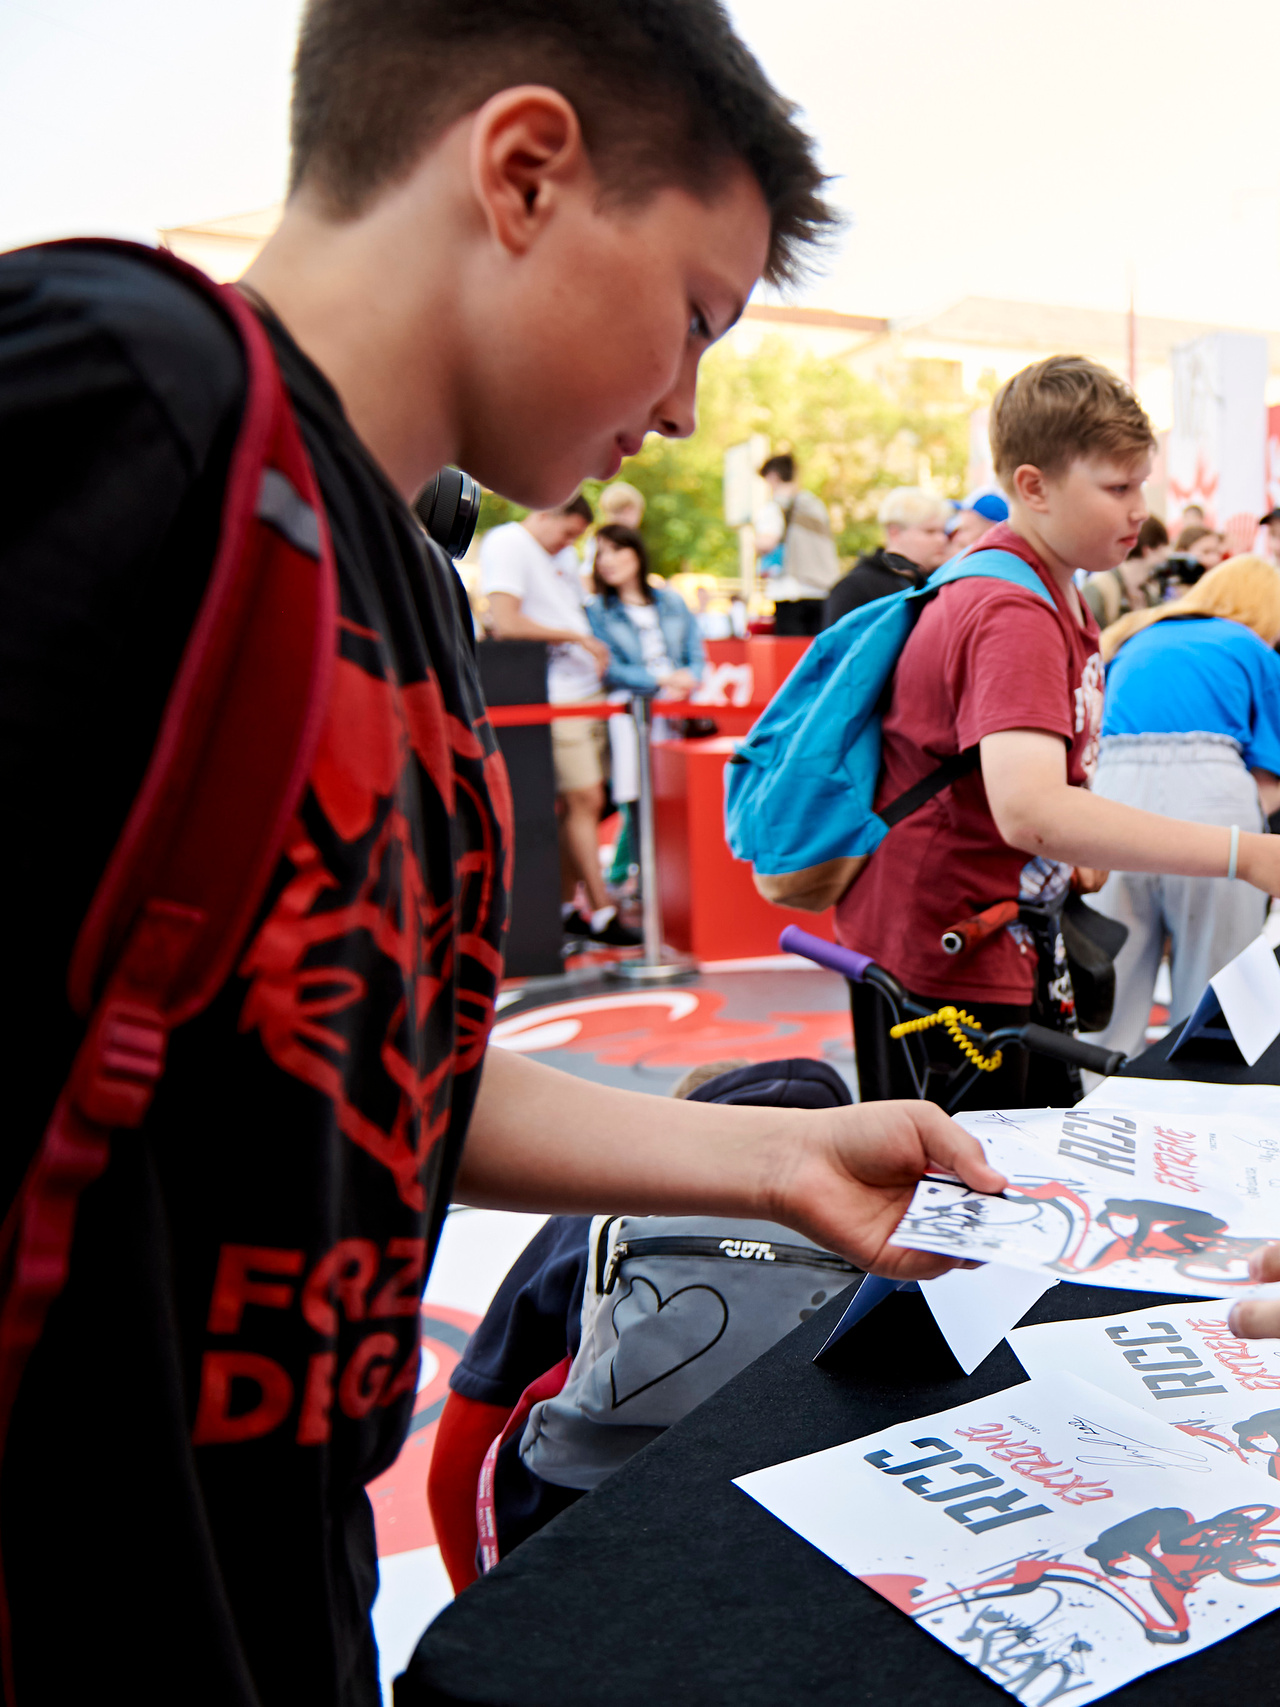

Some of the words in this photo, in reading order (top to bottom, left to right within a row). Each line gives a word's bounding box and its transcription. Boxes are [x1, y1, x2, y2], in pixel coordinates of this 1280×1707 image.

[1057, 1110, 1137, 1176] RCC
[1152, 1125, 1207, 1193] EXTREME
[1104, 1320, 1229, 1401] RCC
[862, 1436, 1055, 1536] RCC
[953, 1422, 1115, 1507] EXTREME
